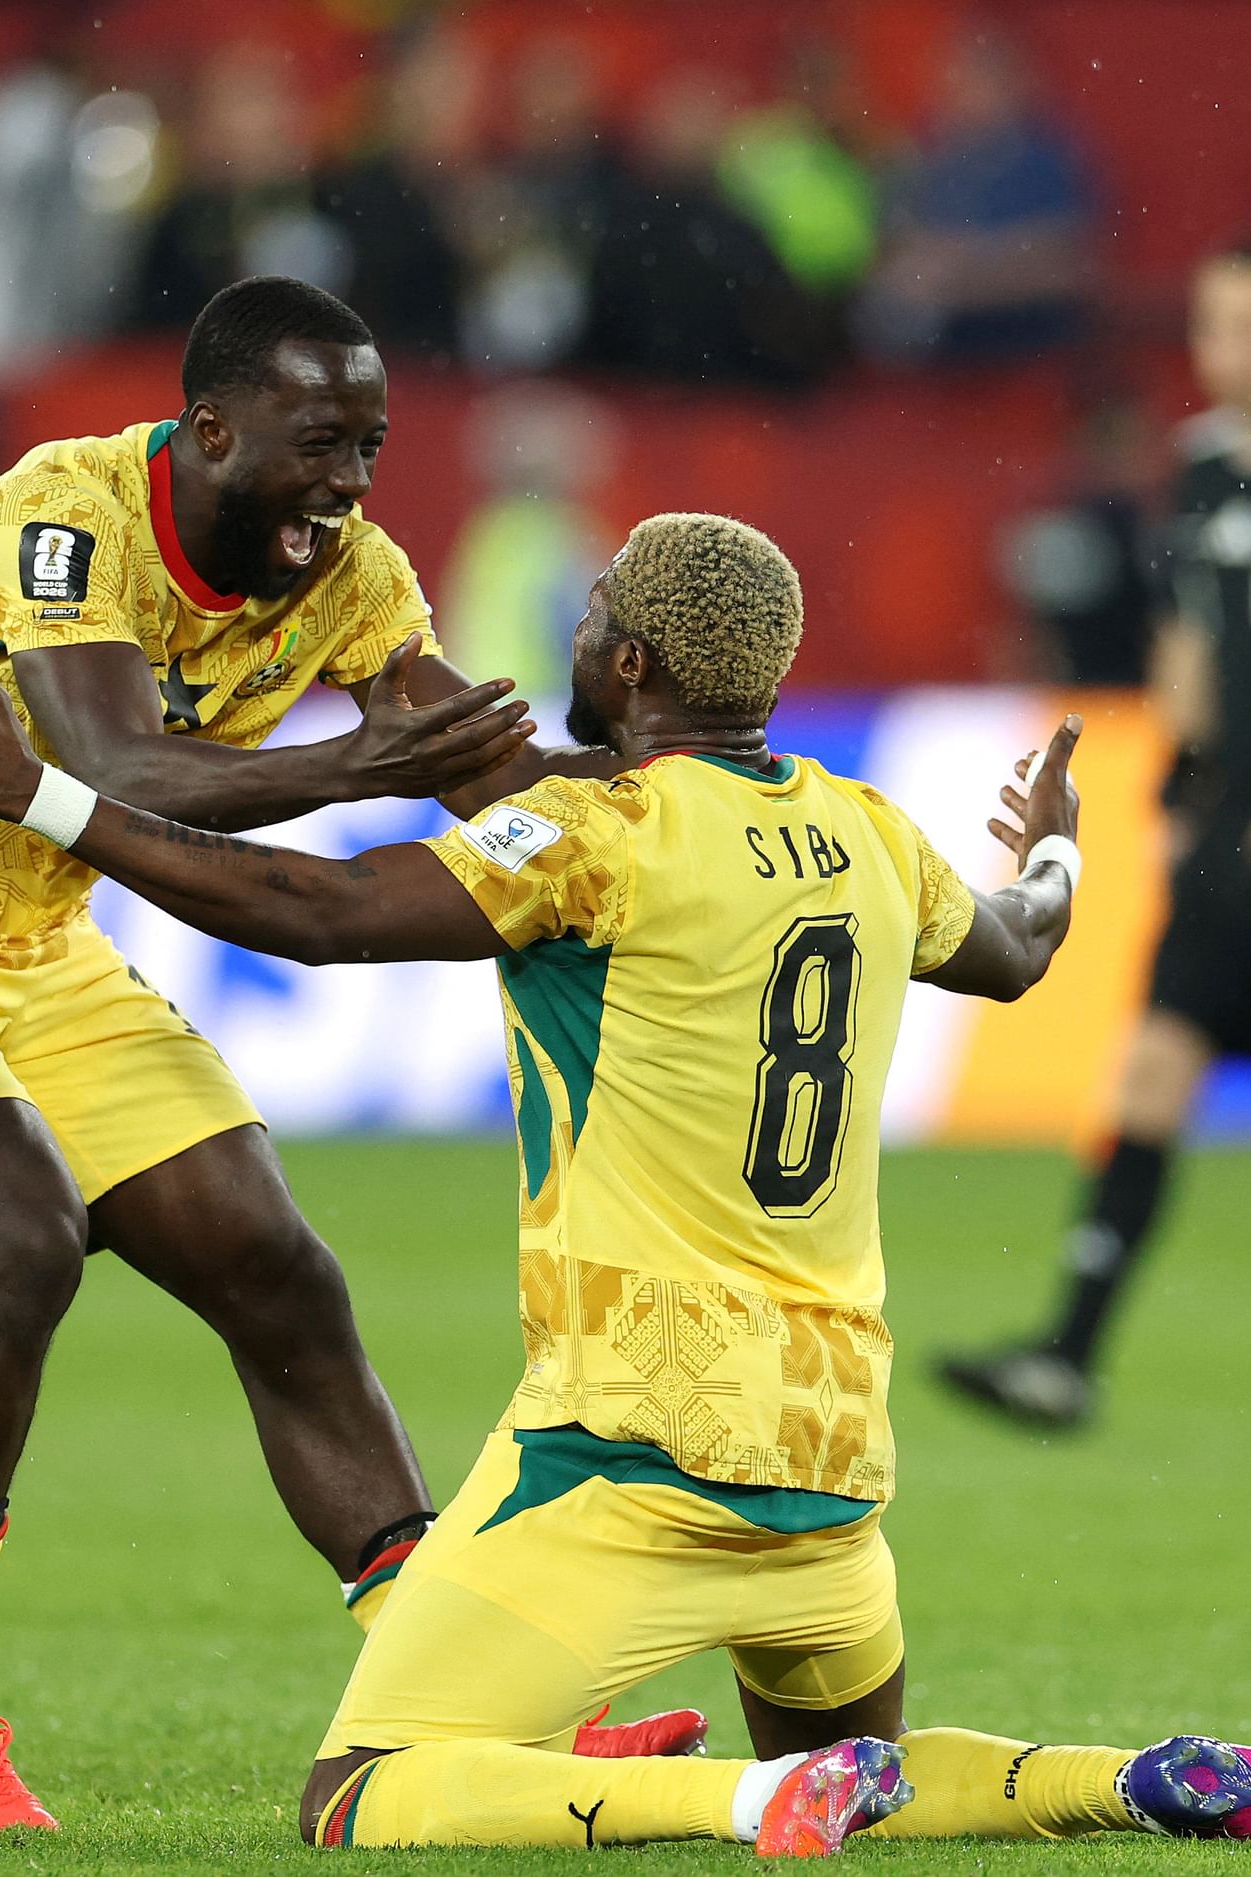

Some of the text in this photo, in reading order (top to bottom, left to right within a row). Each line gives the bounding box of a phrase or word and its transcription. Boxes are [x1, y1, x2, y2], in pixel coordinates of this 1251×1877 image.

[33, 587, 68, 597] 2026
[480, 835, 497, 851] FIFA
[741, 911, 862, 1219] 8
